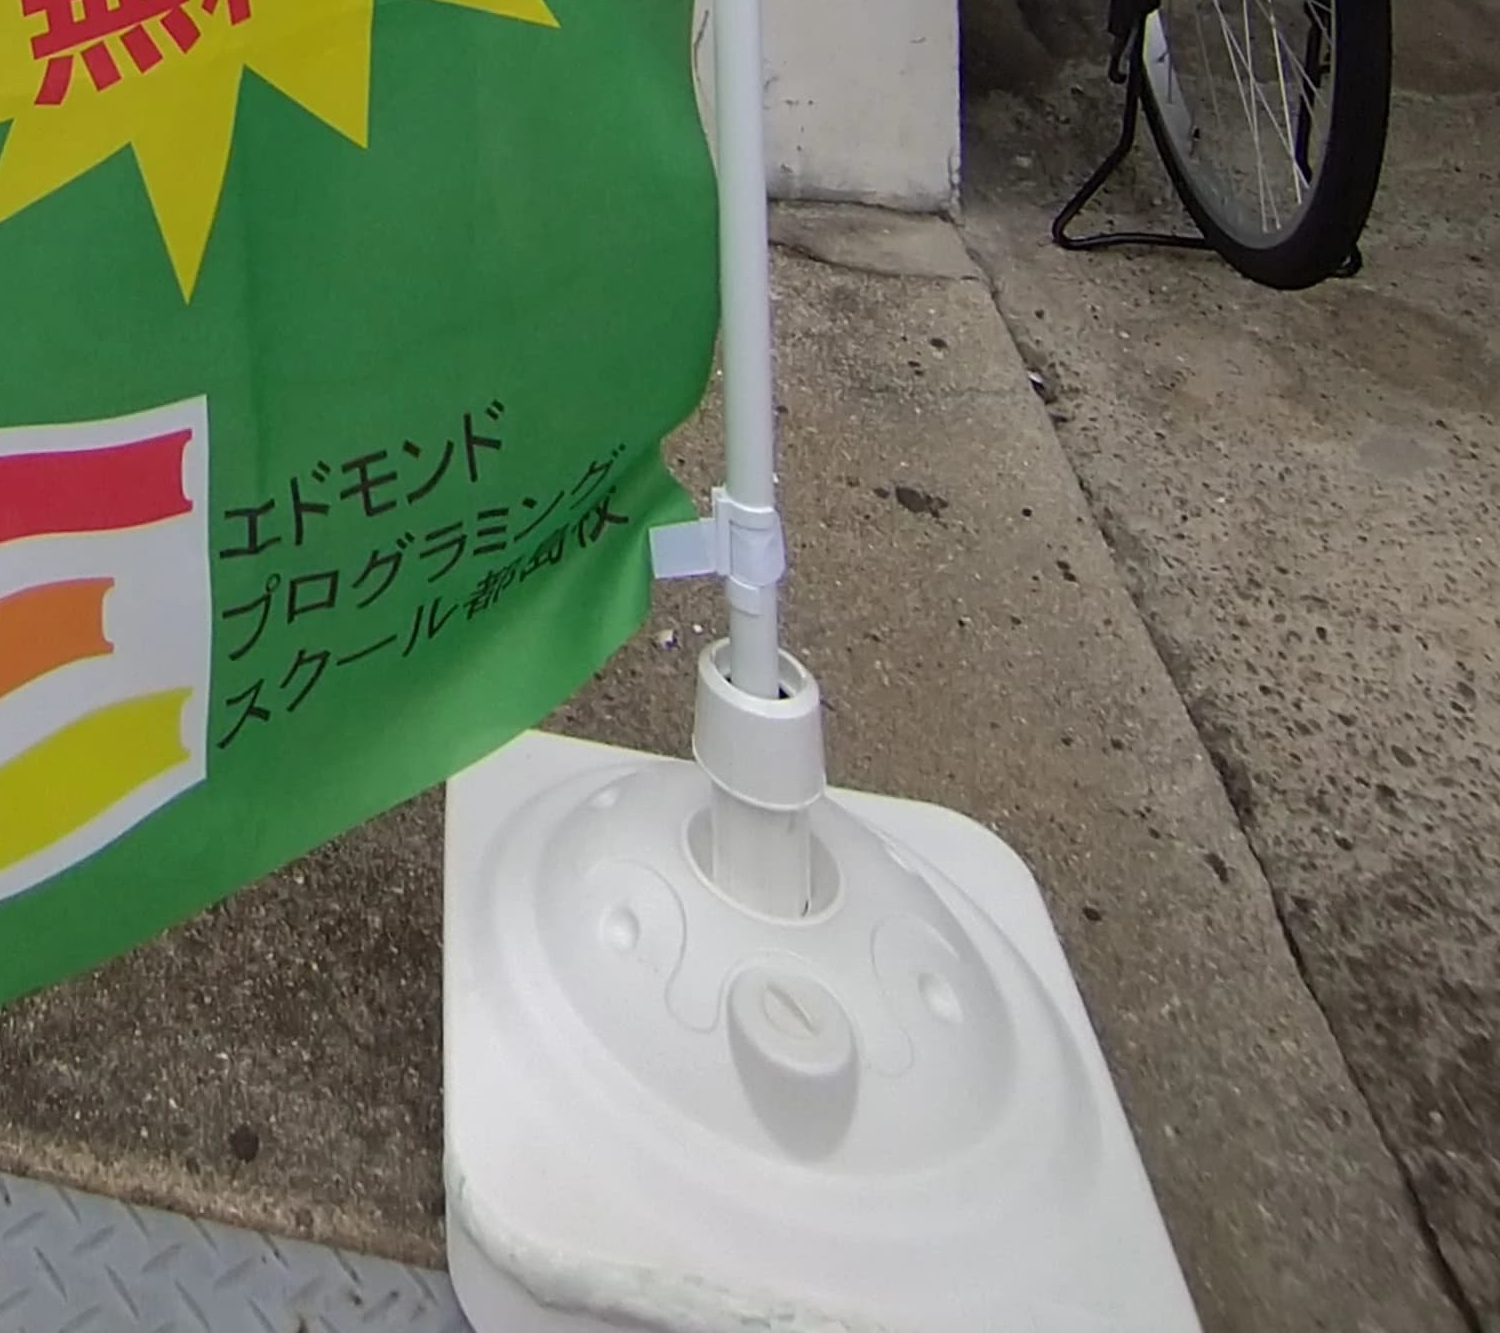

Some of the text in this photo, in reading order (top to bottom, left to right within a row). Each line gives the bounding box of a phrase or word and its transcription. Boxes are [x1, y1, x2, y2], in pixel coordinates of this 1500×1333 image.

[219, 397, 506, 560] エドモンド
[222, 442, 627, 662] プログラミング
